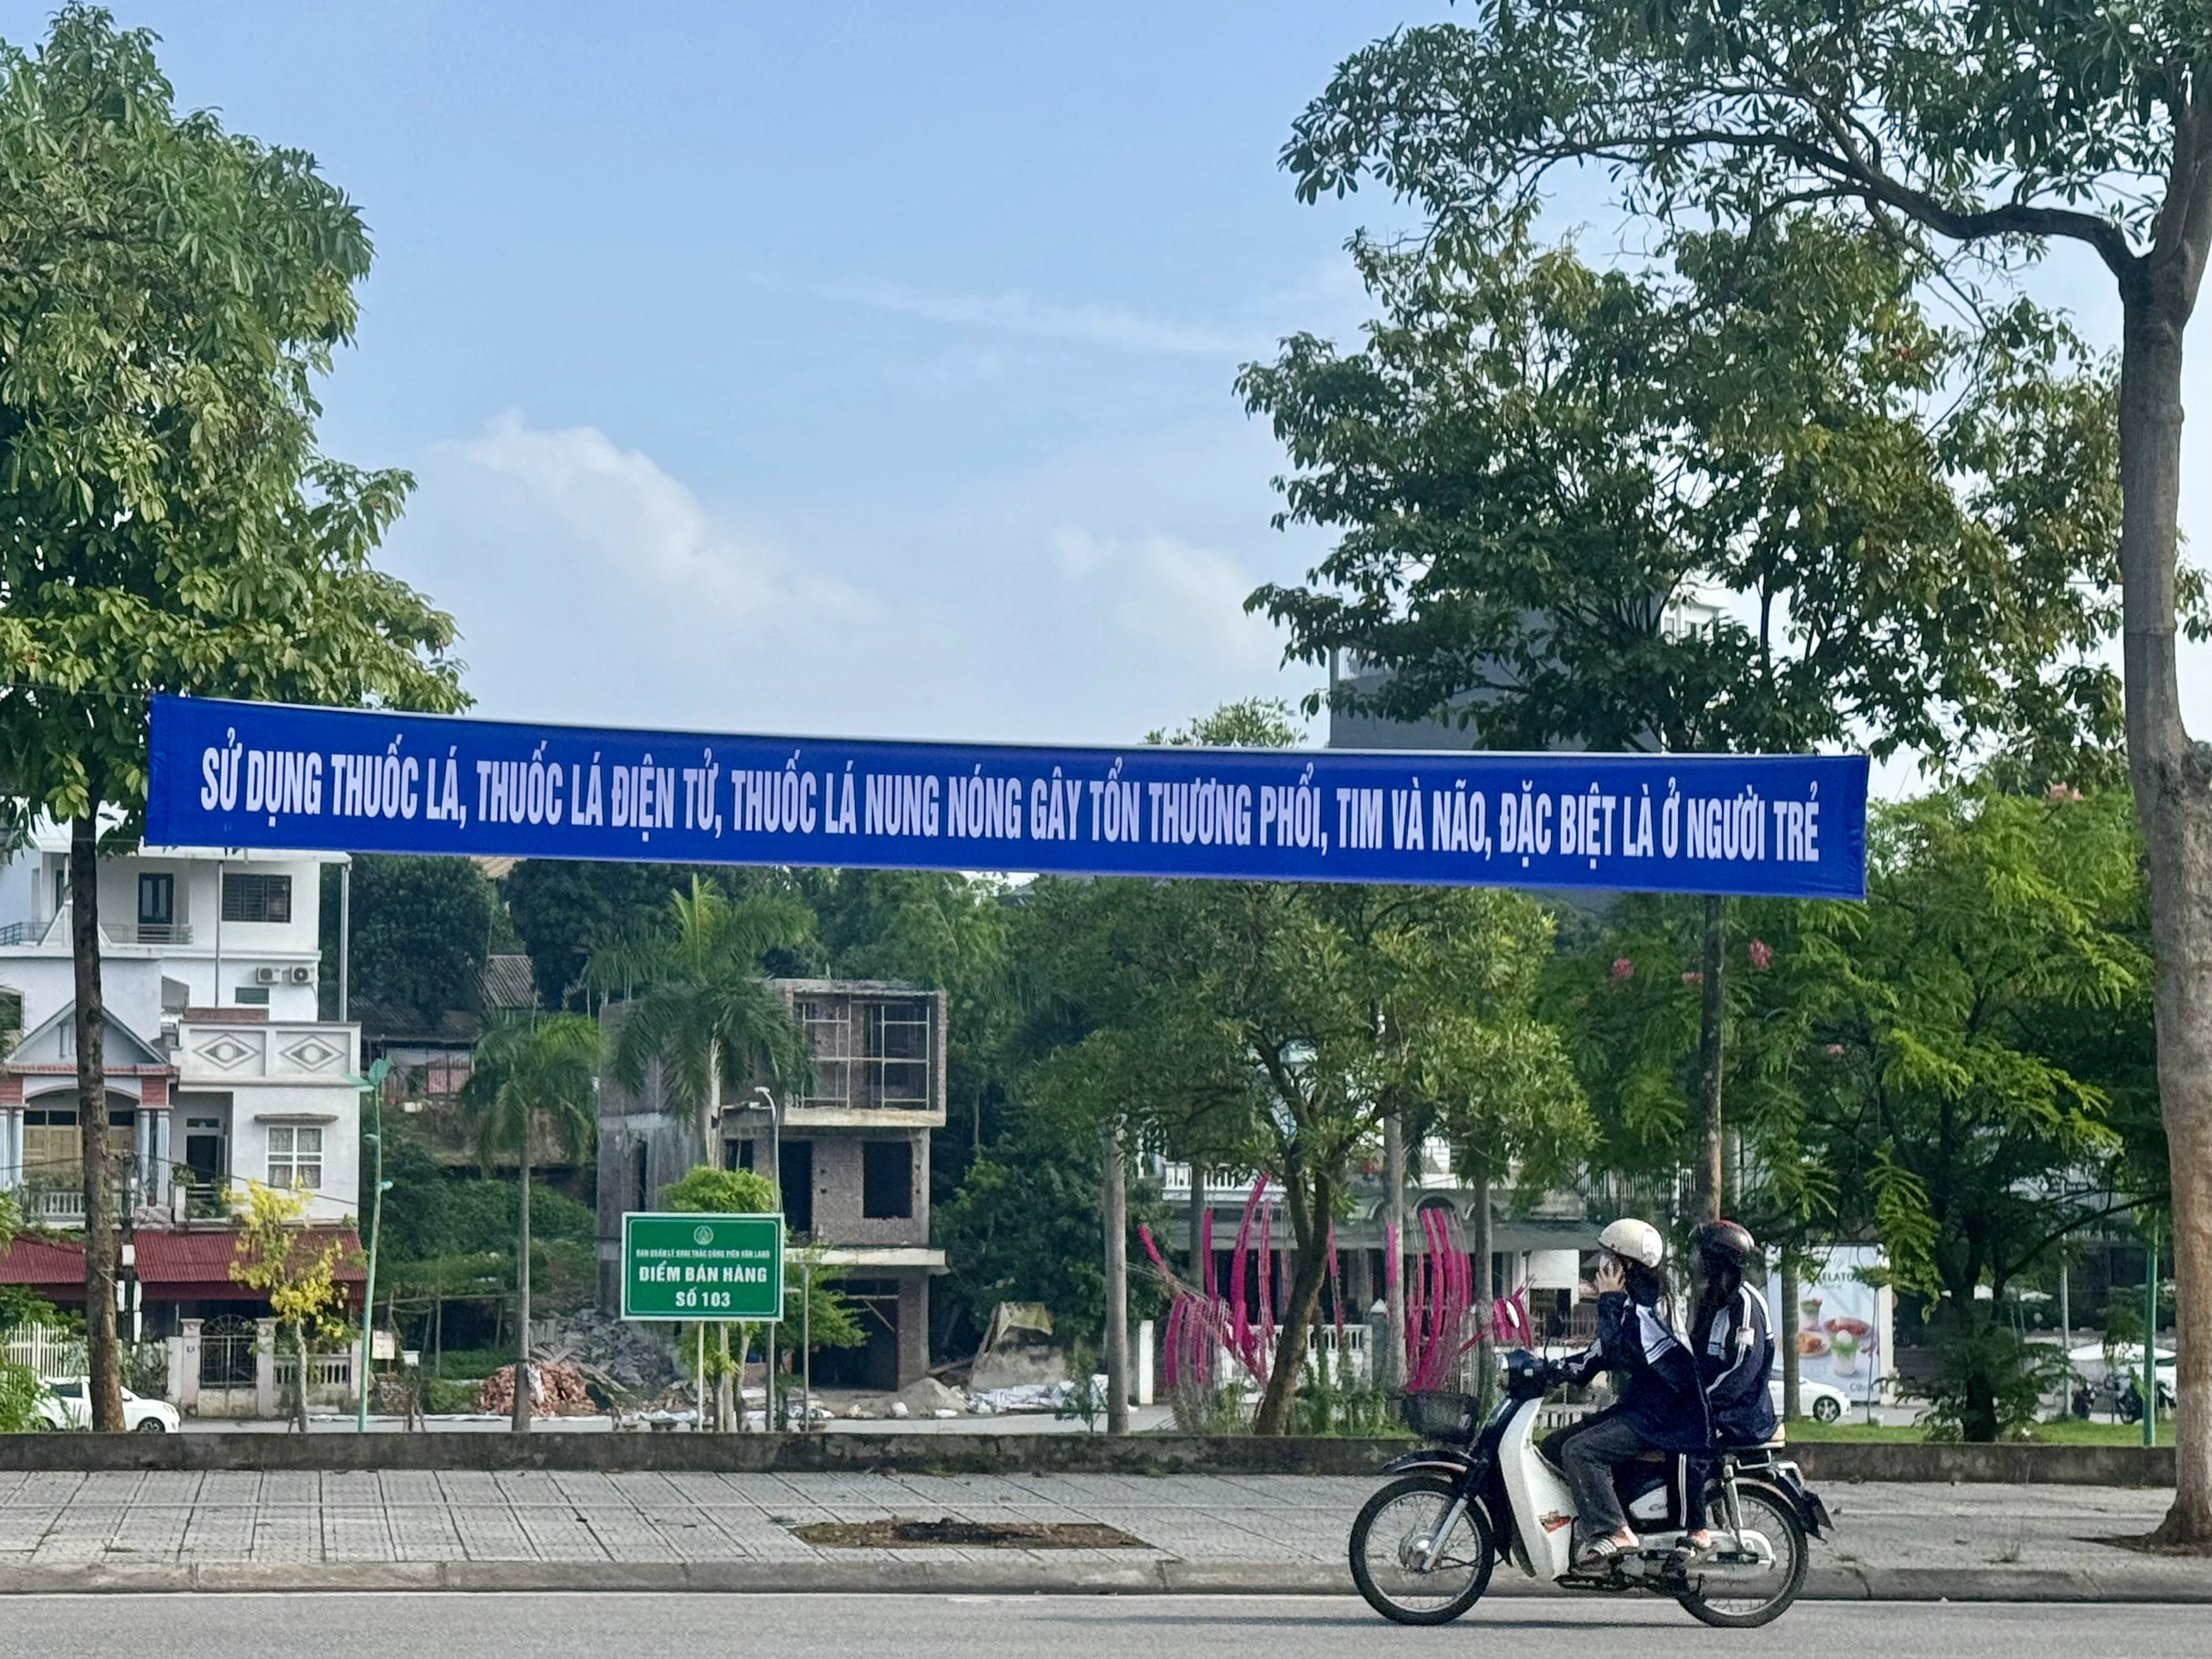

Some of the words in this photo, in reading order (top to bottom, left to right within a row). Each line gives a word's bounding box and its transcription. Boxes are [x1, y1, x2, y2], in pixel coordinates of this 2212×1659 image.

[200, 727, 243, 811] SỬ
[246, 750, 322, 827] DỤNG
[331, 733, 418, 819] THUỐC
[426, 746, 467, 829] LÁ,
[476, 740, 563, 825] THUỐC
[571, 751, 603, 826] LÁ
[611, 754, 675, 842] ĐIỆN
[683, 747, 722, 839] TỬ,
[731, 749, 817, 834] THUỐC
[825, 760, 857, 834] LÁ
[865, 774, 939, 837] NUNG
[948, 764, 1021, 839] NÓNG
[1030, 766, 1082, 840] GÂY
[1089, 756, 1140, 842] TỔN
[1148, 777, 1252, 846] THƯƠNG
[1260, 762, 1328, 856] PHỔI,
[1336, 788, 1383, 849] TIM
[1392, 777, 1425, 850] VÀ
[1432, 779, 1492, 860] NÃO,
[1499, 780, 1552, 867] ĐẶC
[1560, 782, 1616, 869] BIỆT
[1623, 784, 1654, 856] LÀ
[1662, 777, 1680, 858] Ở
[1687, 785, 1765, 860] NGƯỜI
[1773, 781, 1819, 862] TRẺ
[638, 1260, 681, 1282] ĐIỂM
[685, 1263, 719, 1282] BÁN
[723, 1263, 768, 1283] HÀNG
[675, 1286, 697, 1307] SỐ
[702, 1291, 731, 1307] 103
